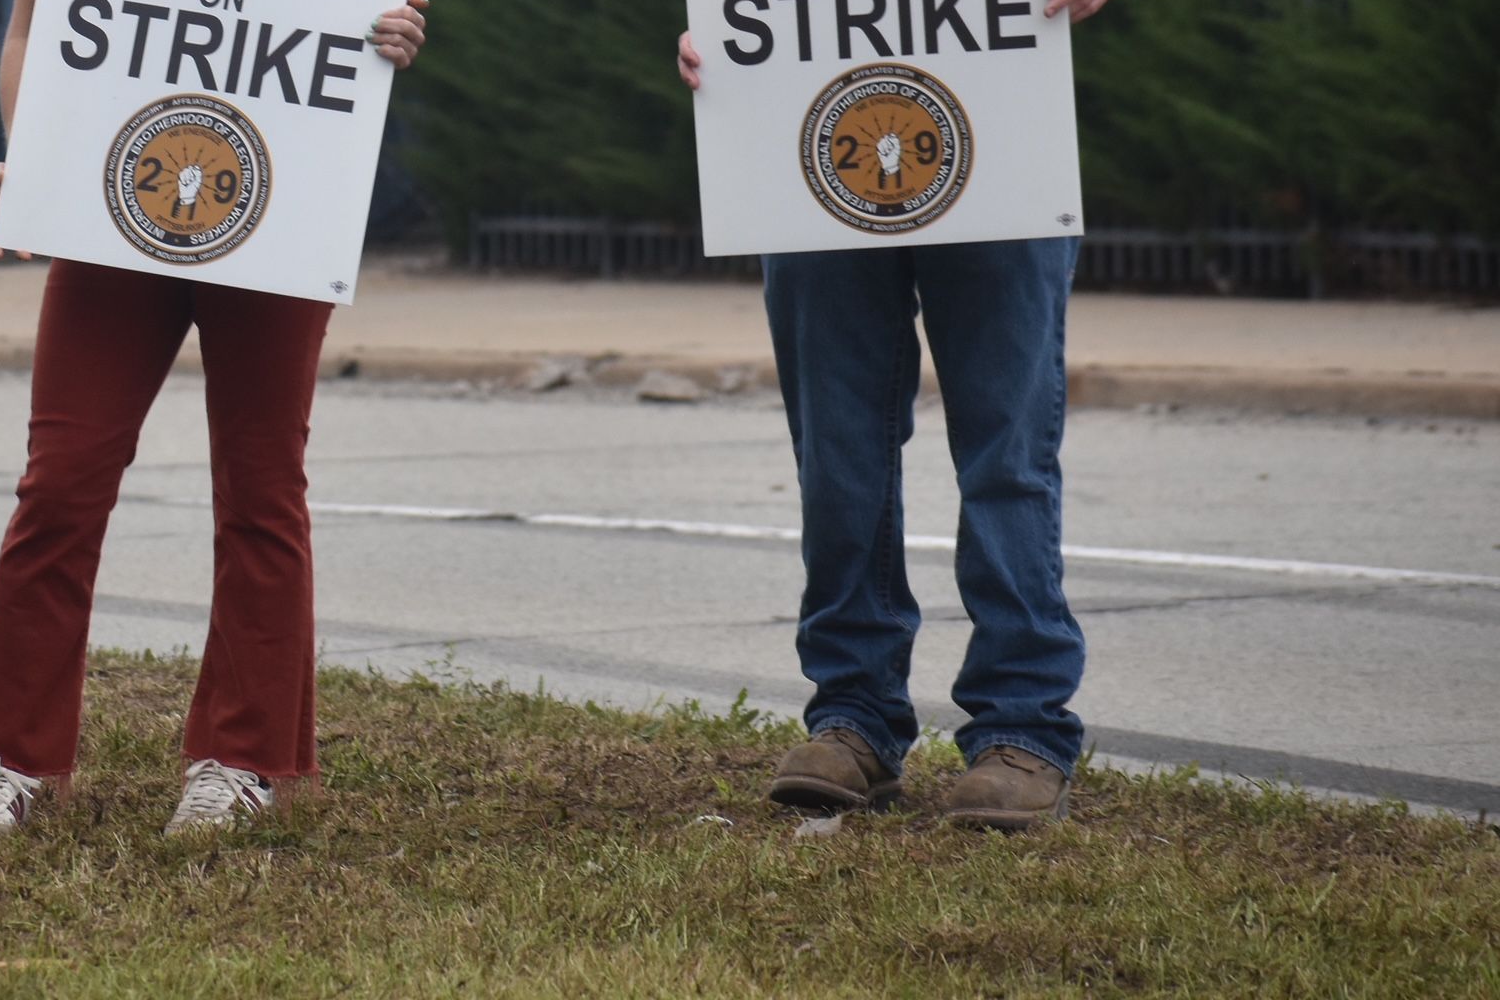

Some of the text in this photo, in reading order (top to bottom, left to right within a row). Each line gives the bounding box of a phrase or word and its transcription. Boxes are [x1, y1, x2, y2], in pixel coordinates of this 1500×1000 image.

[822, 83, 898, 136] BROTHERHOOD
[900, 86, 917, 99] OF
[835, 131, 938, 170] 2 9
[916, 93, 953, 163] ELECTRICAL
[124, 114, 251, 245] INTERNATIONAL BROTHERHOOD OF ELECTRICAL WORKERS
[137, 157, 237, 204] 2 9
[820, 138, 877, 213] INTERNATIONAL
[903, 164, 950, 212] WORKERS
